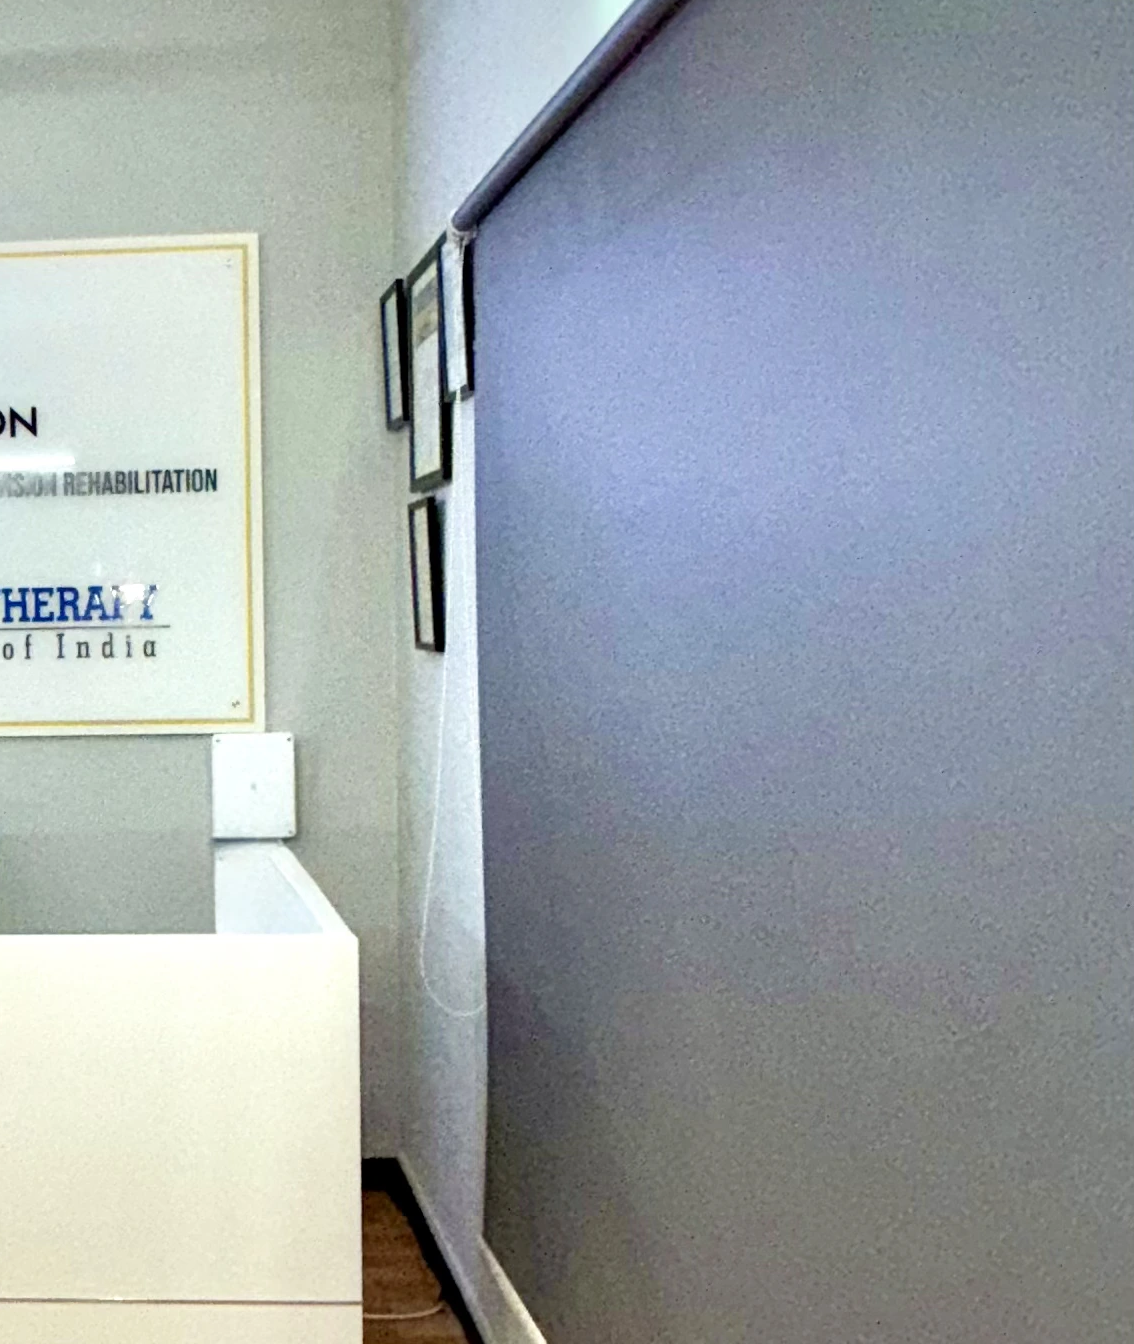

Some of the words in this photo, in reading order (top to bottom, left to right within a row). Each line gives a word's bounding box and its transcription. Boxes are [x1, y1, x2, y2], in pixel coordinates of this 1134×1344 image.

[63, 468, 218, 497] REHABILITATION
[2, 633, 32, 661] of
[56, 632, 158, 659] India
